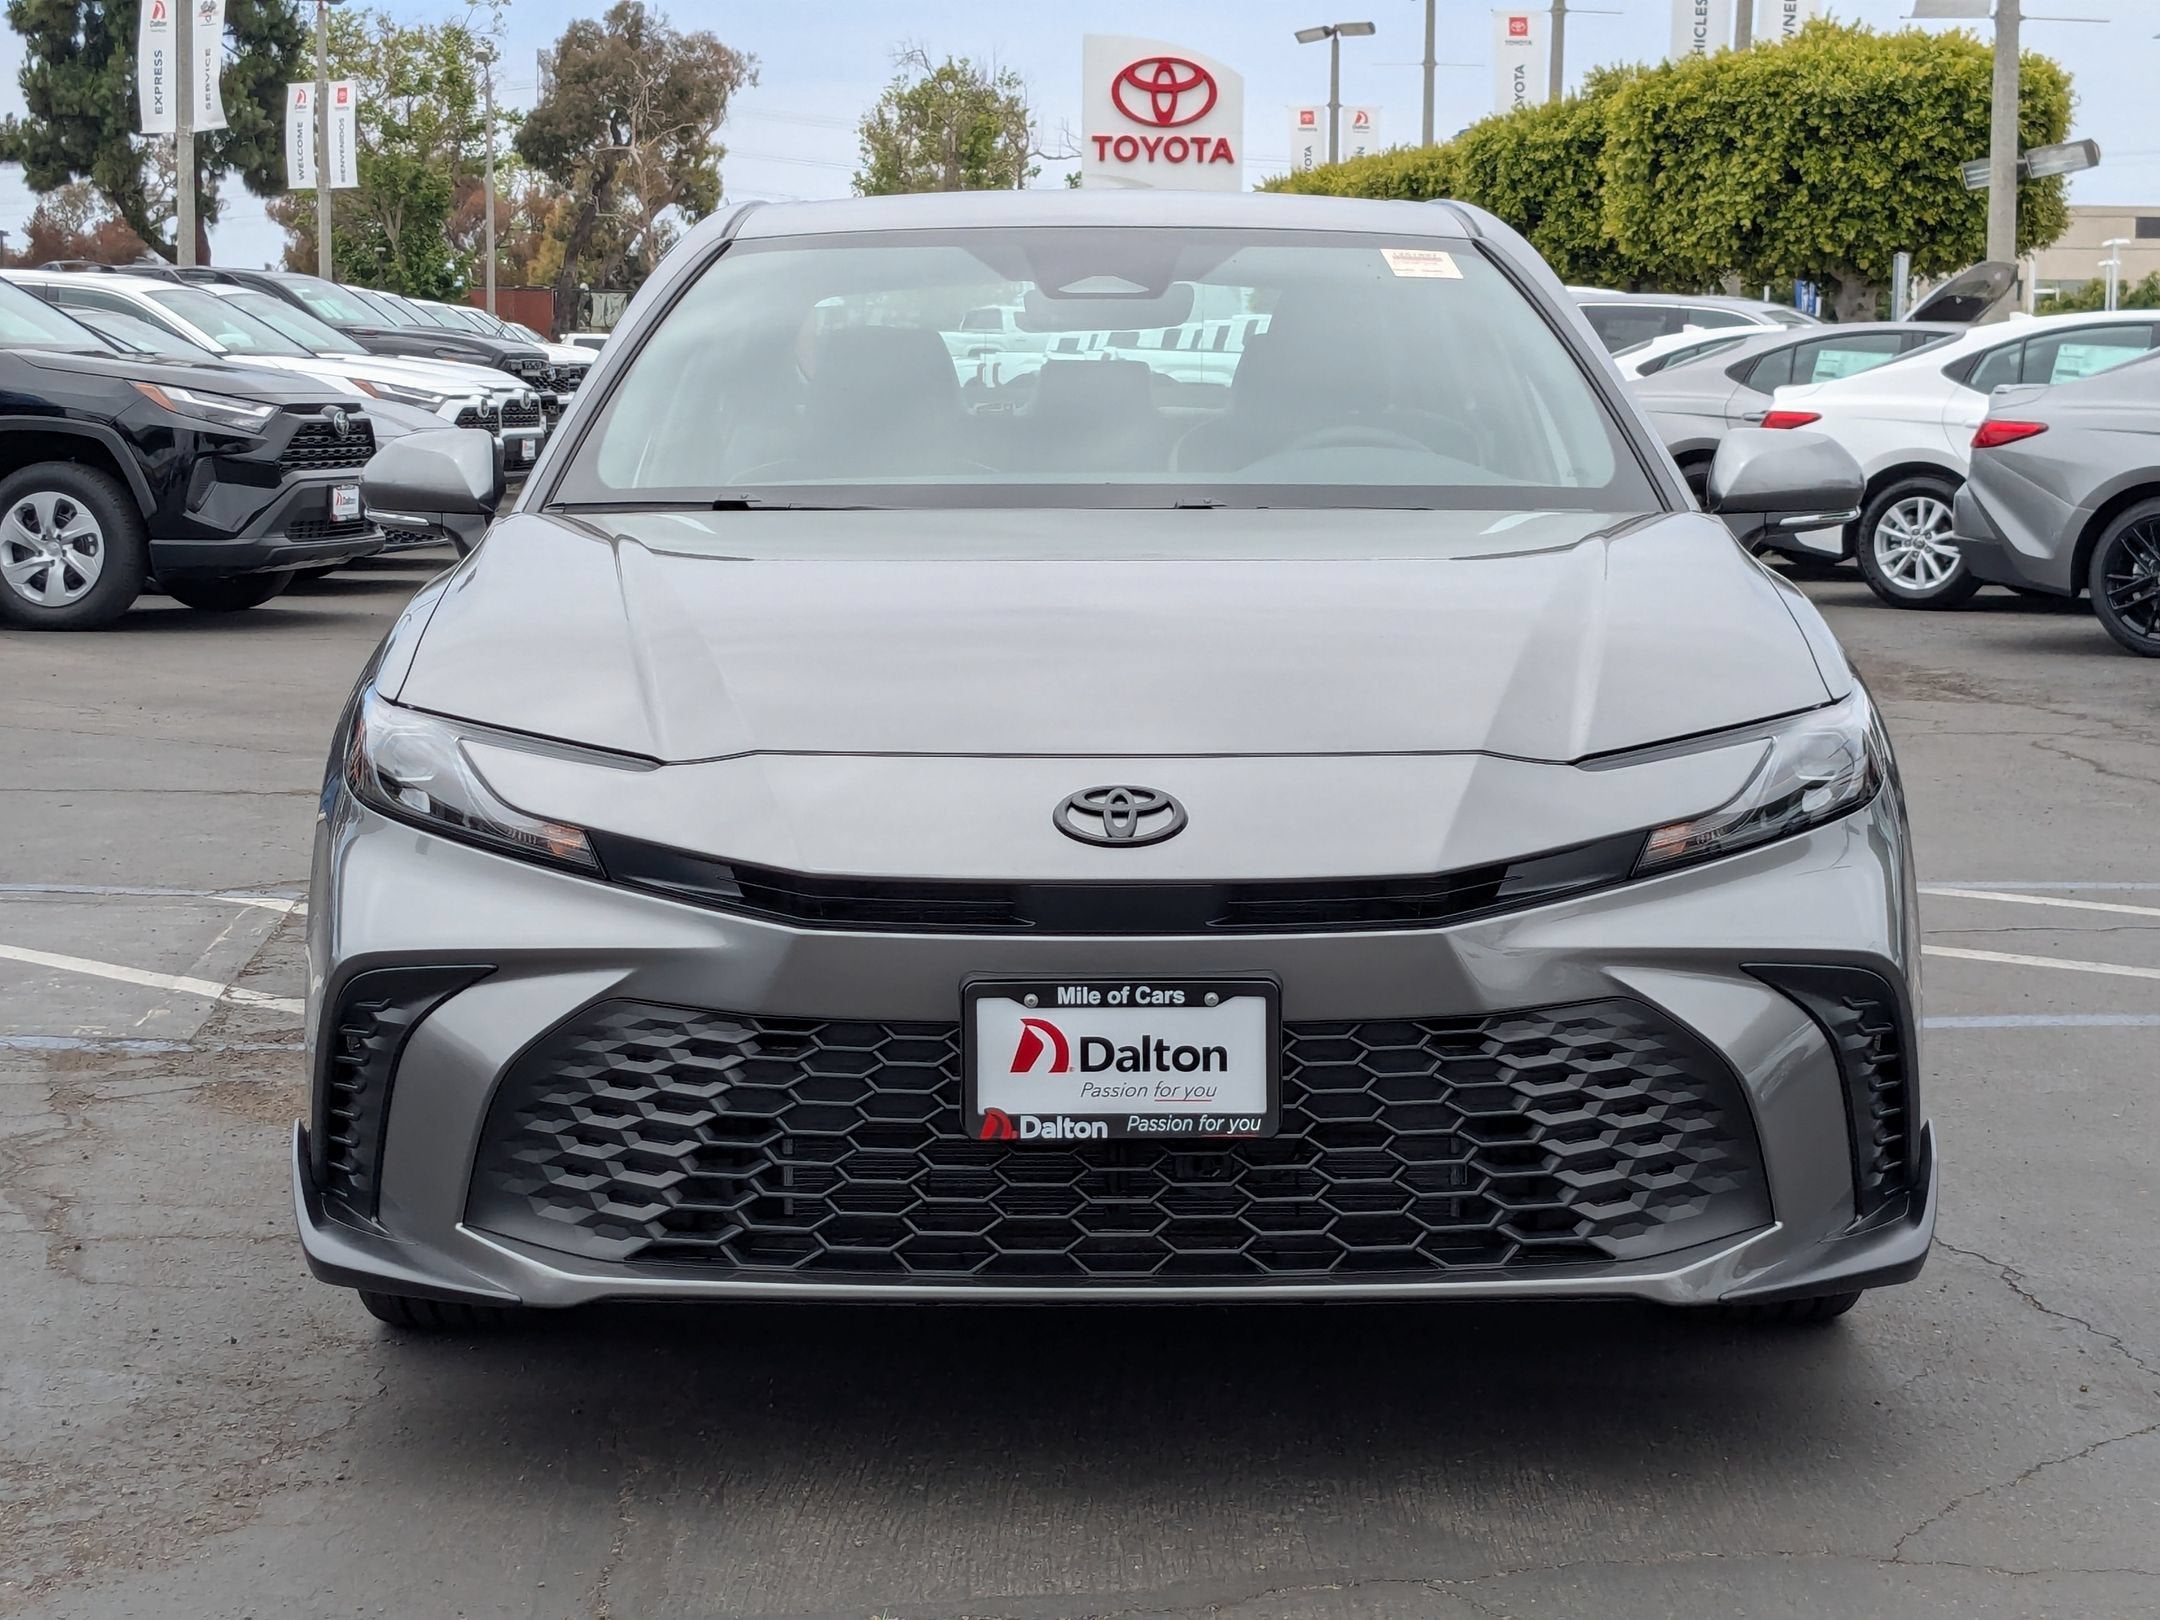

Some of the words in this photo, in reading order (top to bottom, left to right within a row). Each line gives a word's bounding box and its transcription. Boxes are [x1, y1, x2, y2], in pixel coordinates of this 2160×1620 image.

[154, 49, 163, 114] EXPRESS
[297, 122, 305, 180] WELCOME
[1091, 135, 1234, 164] TOYOTA
[1057, 986, 1101, 1005] Mile
[1107, 985, 1130, 1004] of
[1135, 985, 1185, 1005] Cars
[1079, 1035, 1228, 1073] Dalton
[1080, 1082, 1148, 1098] Passion
[1153, 1081, 1179, 1098] for
[1184, 1086, 1218, 1100] you
[1020, 1115, 1108, 1139] Dalton
[1127, 1115, 1193, 1132] Passion
[1198, 1114, 1225, 1132] for
[1227, 1119, 1262, 1135] you
